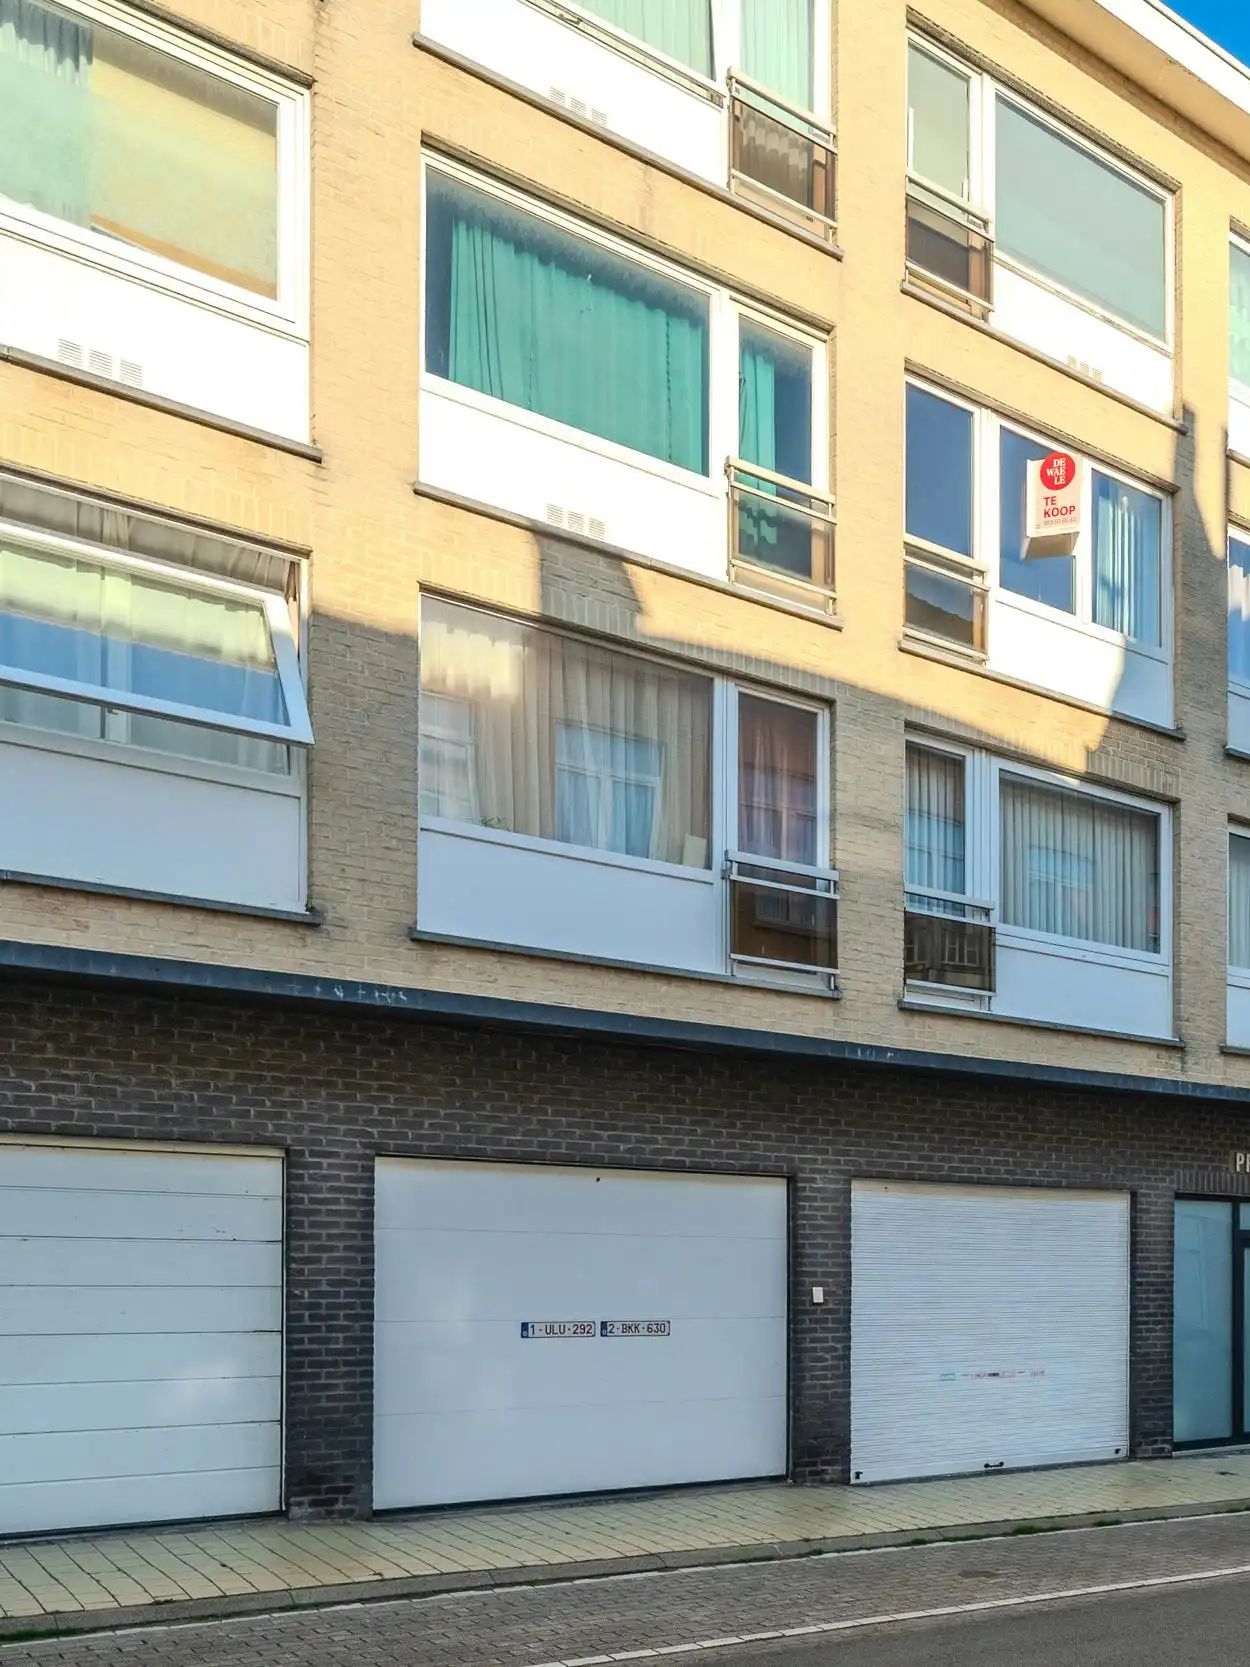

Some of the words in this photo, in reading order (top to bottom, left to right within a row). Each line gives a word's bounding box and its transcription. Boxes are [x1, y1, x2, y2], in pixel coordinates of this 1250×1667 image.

[1053, 458, 1065, 467] DE
[1046, 467, 1065, 477] WAE
[1054, 477, 1065, 485] LE
[1043, 496, 1057, 506] TE
[1044, 505, 1076, 518] KOOP
[530, 1323, 593, 1335] 1-ULU-292
[608, 1322, 666, 1334] 2-BKK-630
